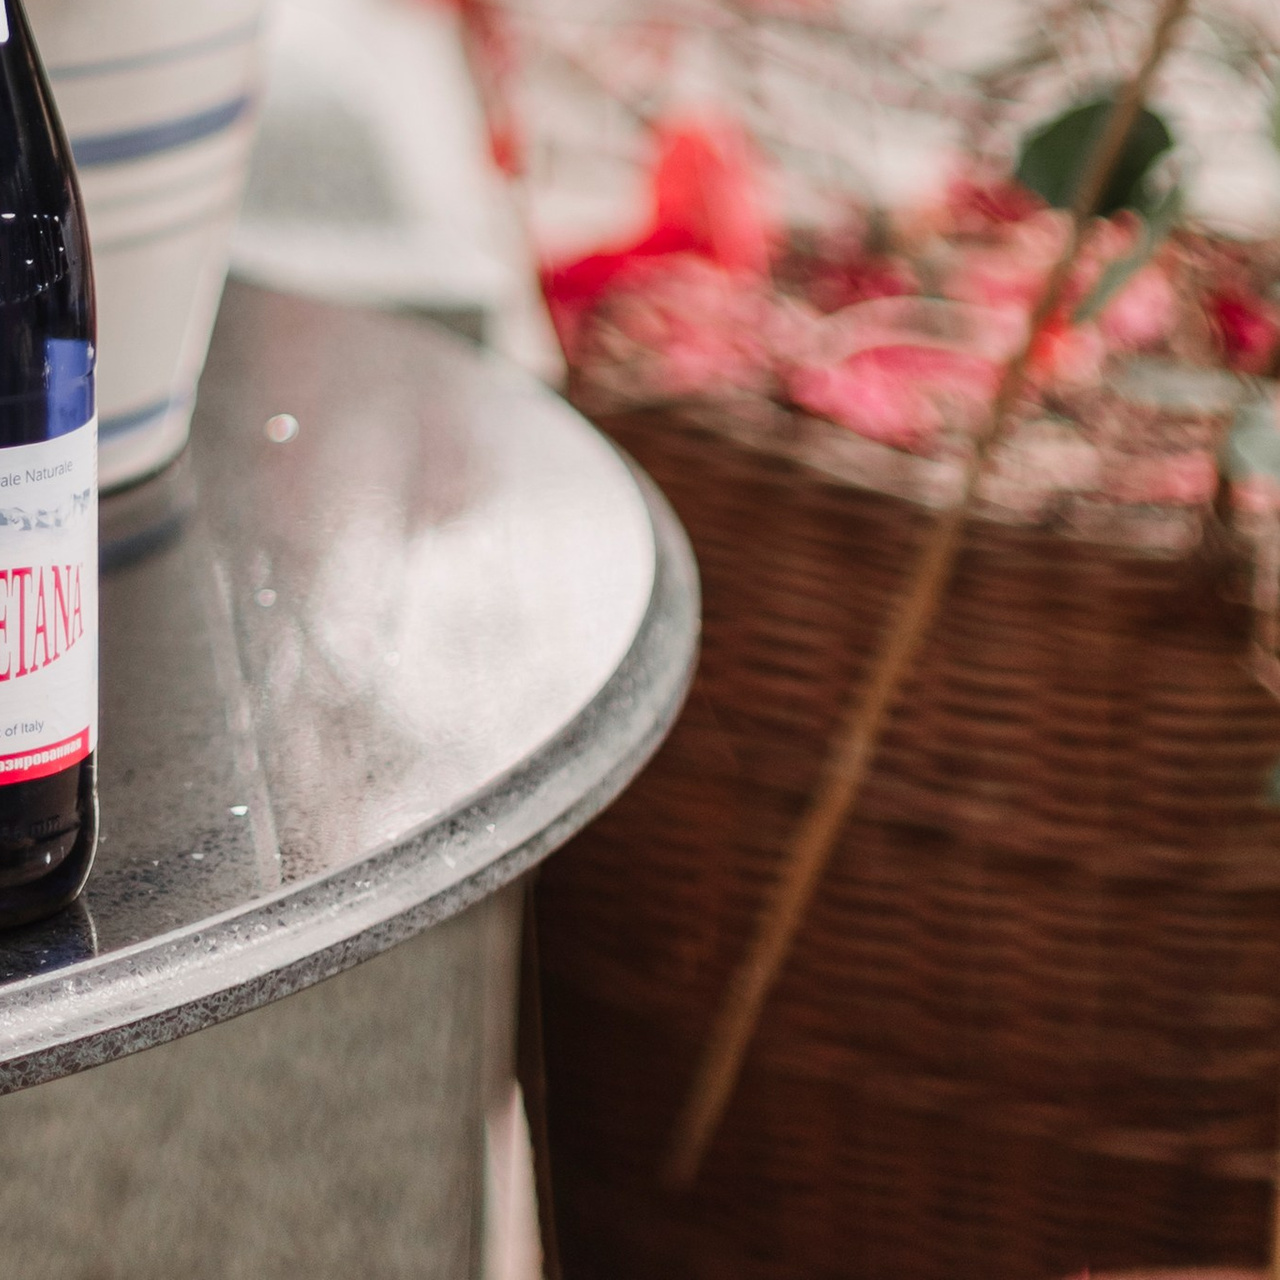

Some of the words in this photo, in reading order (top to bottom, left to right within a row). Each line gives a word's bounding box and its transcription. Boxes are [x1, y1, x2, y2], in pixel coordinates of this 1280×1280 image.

[25, 460, 73, 483] Naturale
[4, 724, 18, 737] of
[21, 720, 44, 735] Italy
